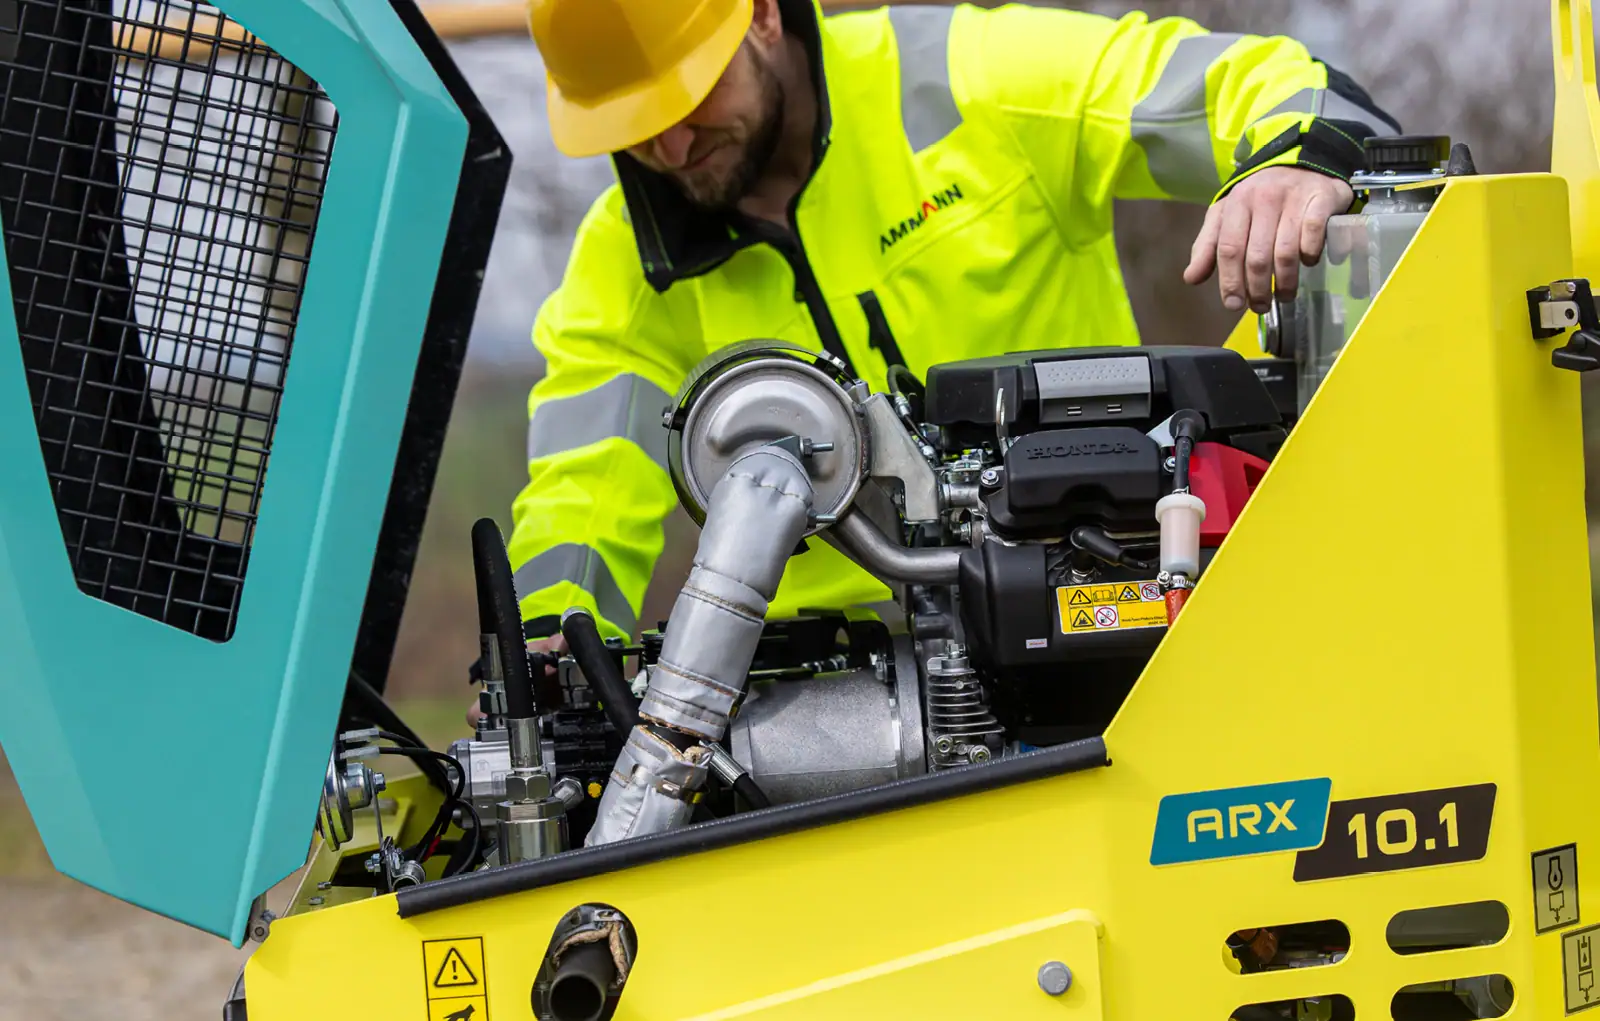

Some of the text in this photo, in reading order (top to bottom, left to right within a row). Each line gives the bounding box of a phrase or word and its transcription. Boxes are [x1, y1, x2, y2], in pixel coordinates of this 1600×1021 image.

[879, 183, 963, 255] AMMANN
[1026, 442, 1140, 460] HONDA
[1187, 798, 1460, 859] ARX 10.1
